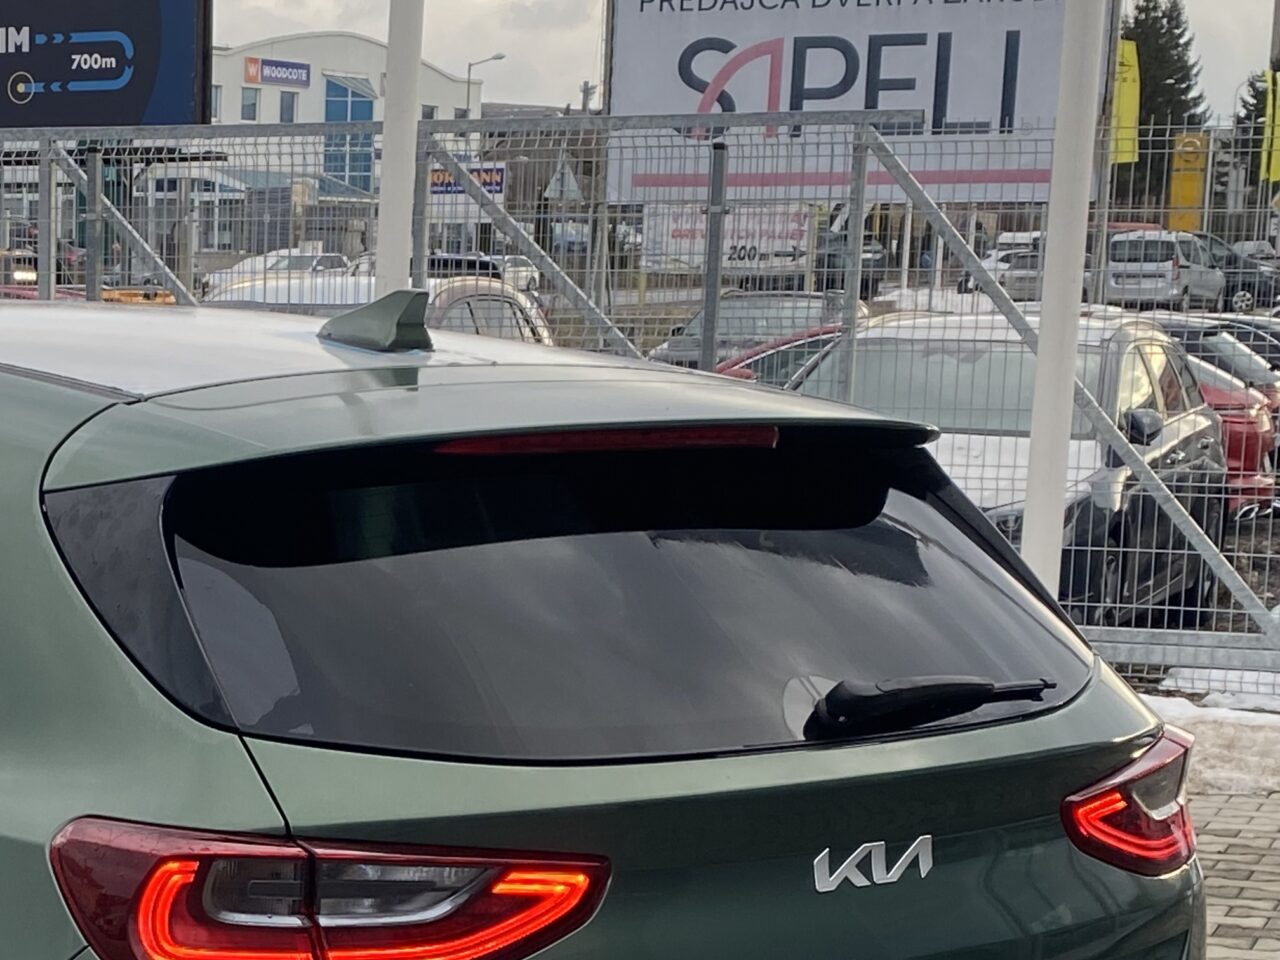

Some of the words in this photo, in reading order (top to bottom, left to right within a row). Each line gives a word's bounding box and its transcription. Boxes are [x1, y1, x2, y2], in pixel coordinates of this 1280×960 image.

[71, 53, 117, 70] 700m
[262, 65, 308, 81] WOODCOTE
[674, 30, 1021, 141] SAPELI
[728, 245, 758, 261] 200
